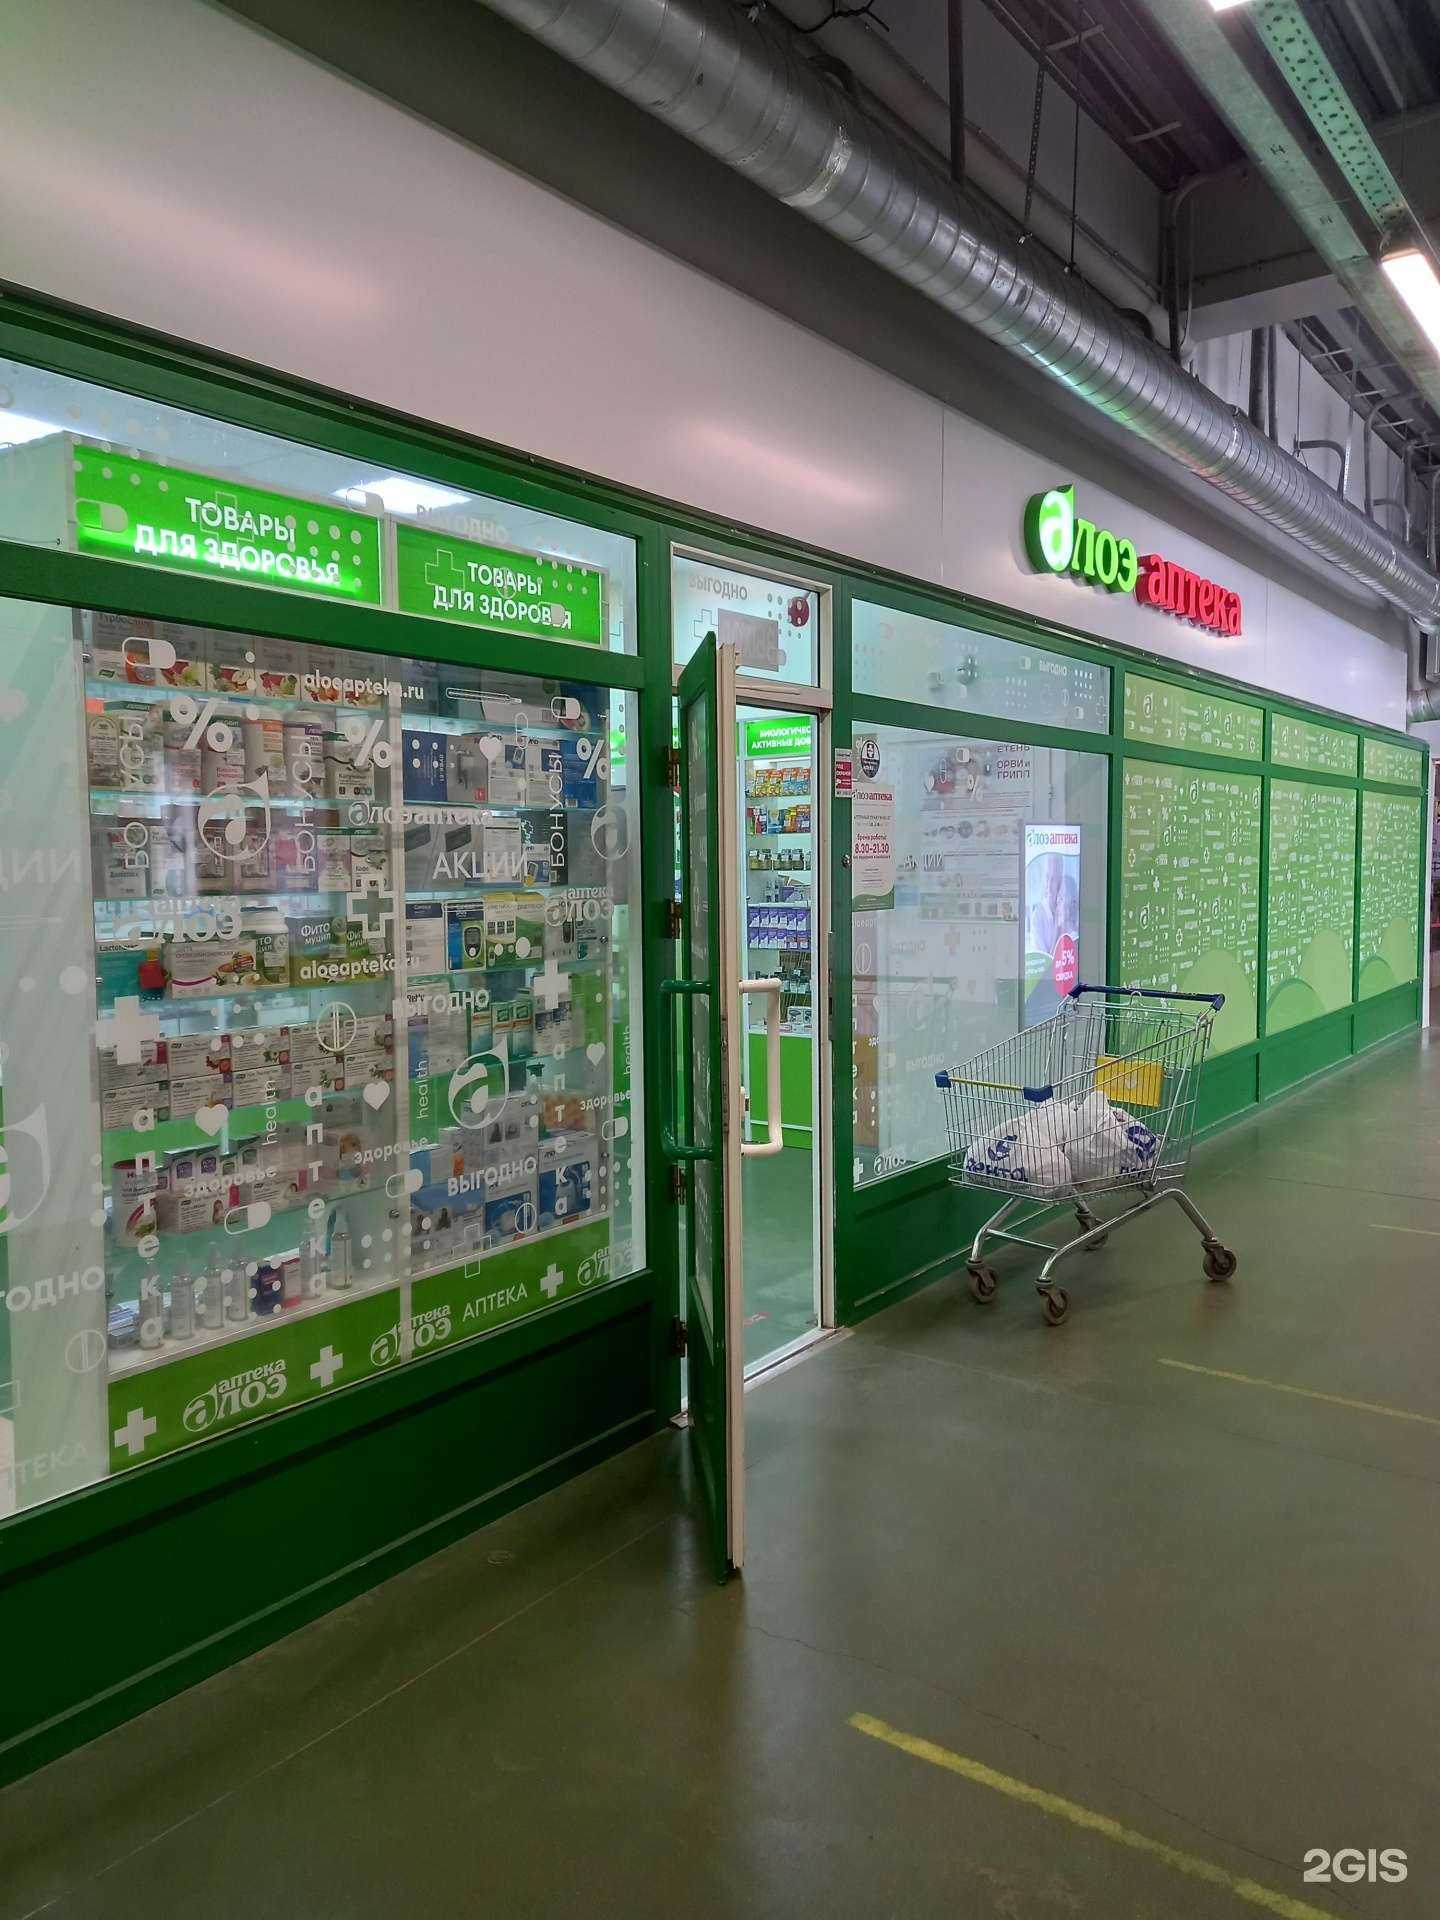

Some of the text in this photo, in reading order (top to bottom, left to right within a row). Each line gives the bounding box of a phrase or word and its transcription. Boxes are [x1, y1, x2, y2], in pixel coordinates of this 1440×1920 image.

[185, 496, 296, 543] ТОВАРЫ
[135, 523, 340, 586] ДЛЯ ЗДОРОВЬЯ
[466, 561, 543, 596] ТОВАРЫ
[433, 585, 572, 630] ДЛЯ ЗДОРОВЯ
[415, 1059, 430, 1120] health
[462, 1282, 528, 1323] АПТЕКА
[217, 1359, 287, 1394] аптека
